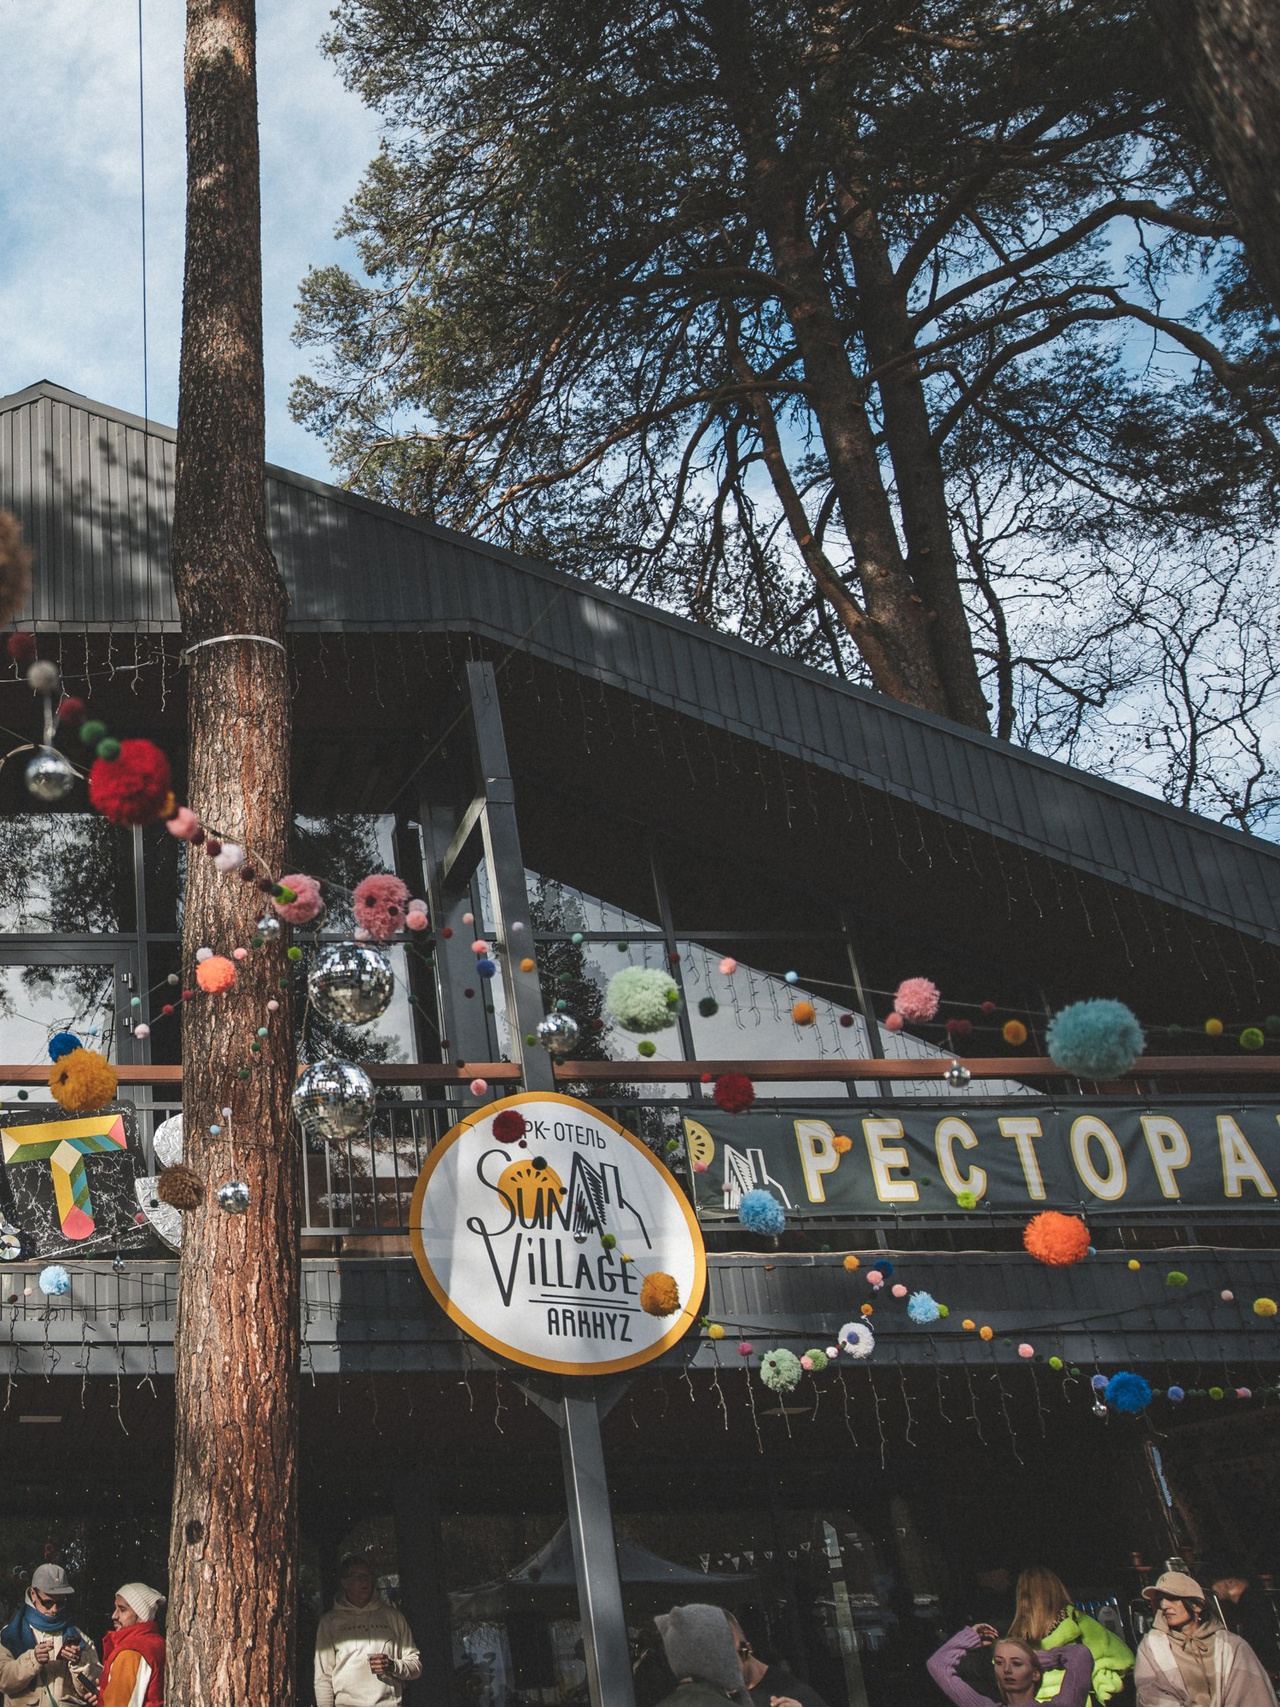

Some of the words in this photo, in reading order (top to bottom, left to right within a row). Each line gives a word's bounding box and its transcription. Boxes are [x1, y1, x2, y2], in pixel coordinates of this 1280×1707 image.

[523, 1120, 606, 1149] РК-ОТЕЛЬ
[793, 1115, 1280, 1202] РЕСТОРА
[547, 1308, 633, 1342] ARKHYZ
